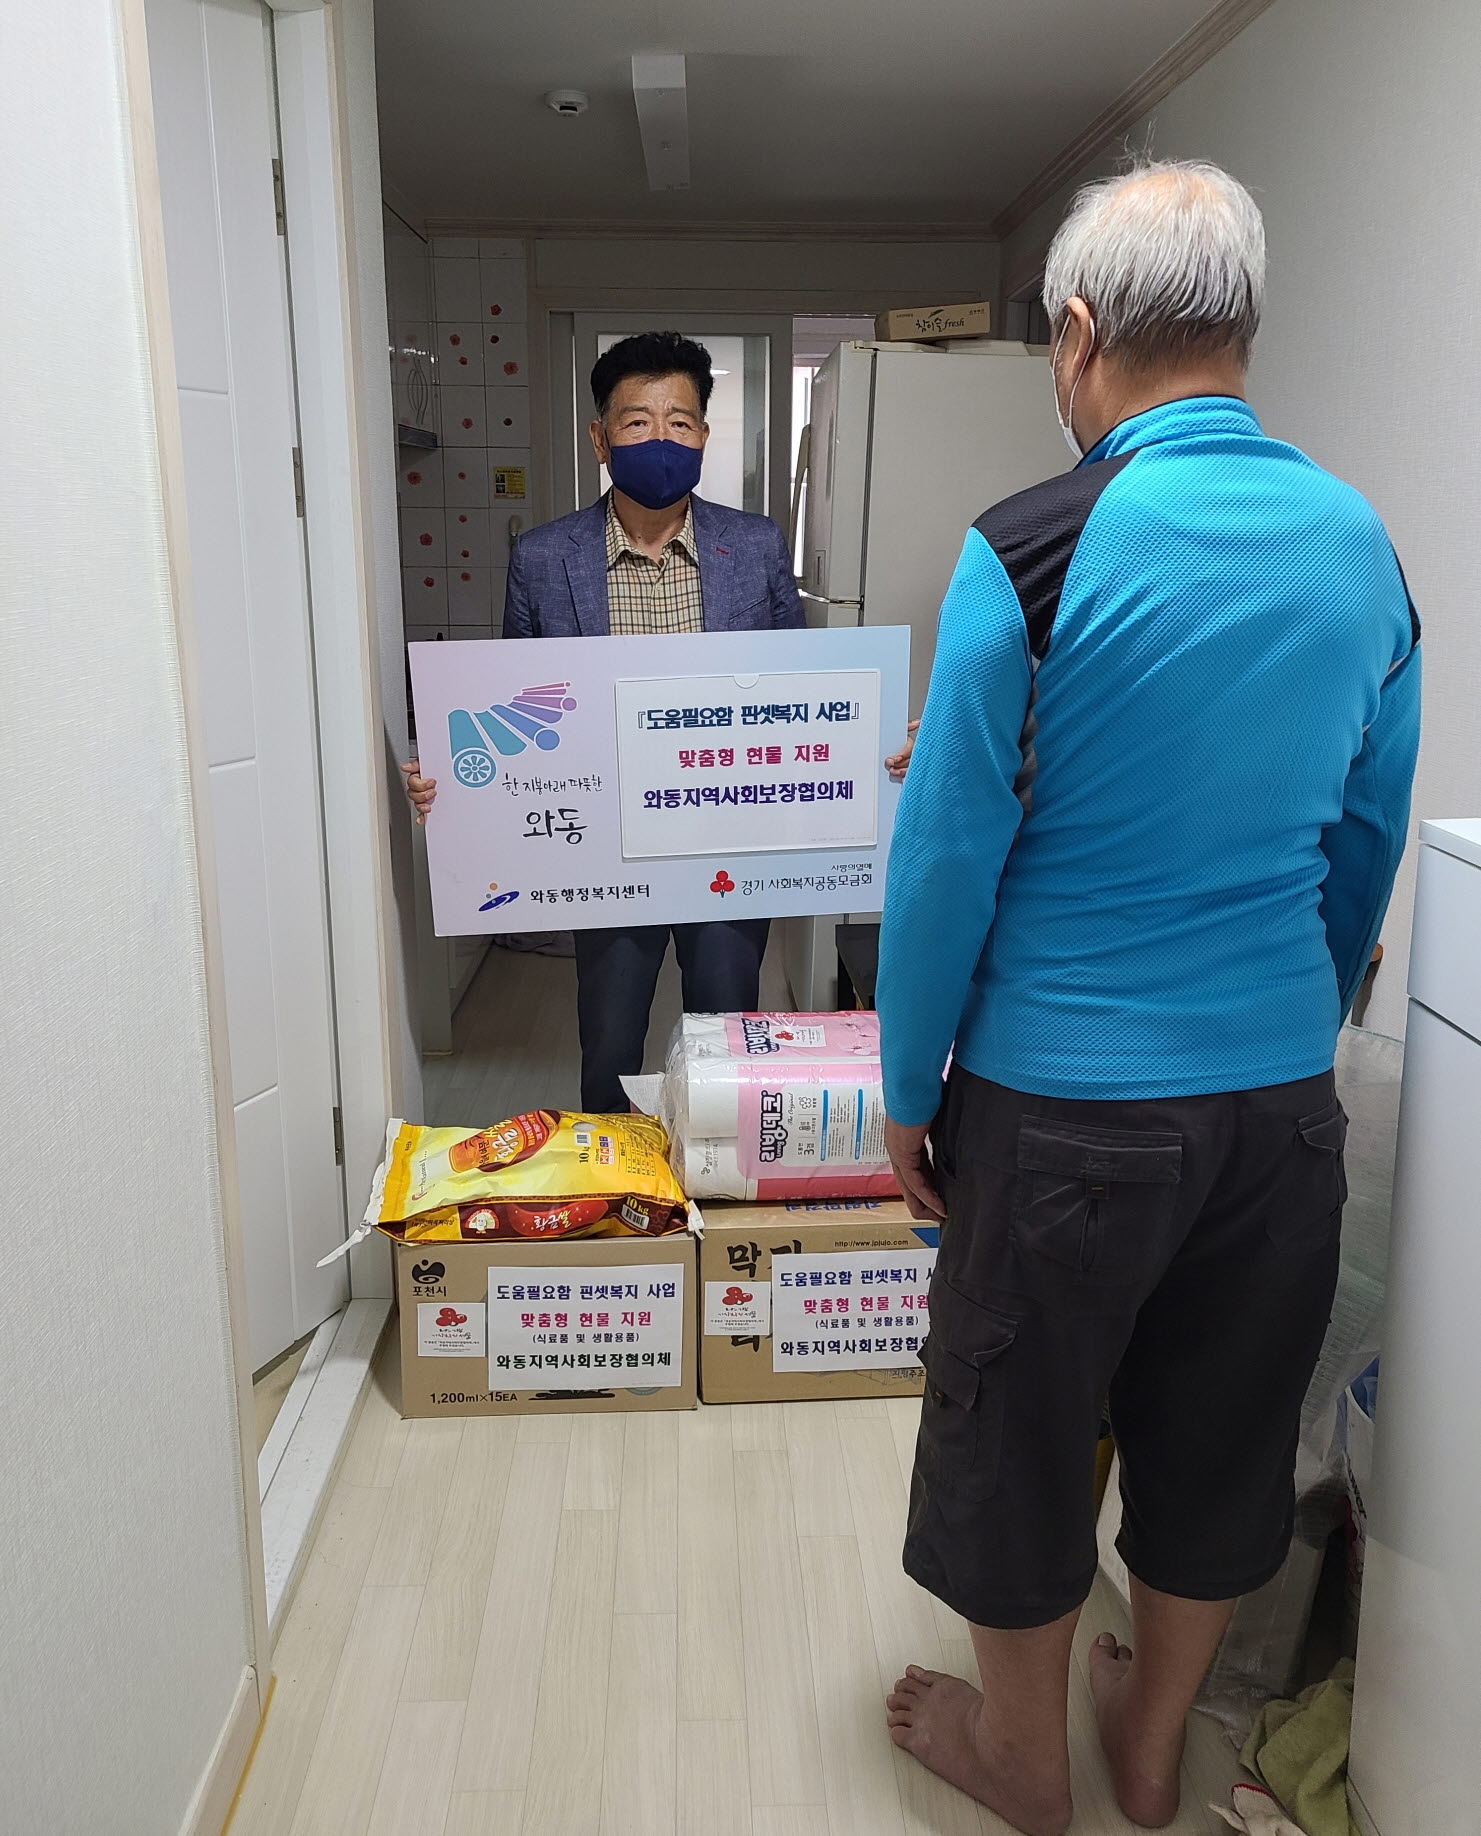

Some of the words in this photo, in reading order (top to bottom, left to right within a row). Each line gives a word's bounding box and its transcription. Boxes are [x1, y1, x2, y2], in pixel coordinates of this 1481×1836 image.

[941, 317, 965, 331] fresh
[678, 748, 735, 768] 맞춤형
[746, 745, 782, 765] 현물
[794, 744, 830, 762] 지원
[502, 772, 519, 797] 한
[643, 780, 854, 809] 와동지역사회보장협의체
[522, 808, 588, 845] 와동
[530, 884, 650, 904] 와동행정복지센터
[741, 879, 764, 896] 경기
[768, 873, 872, 891] 사회복지공동모금회
[760, 1090, 788, 1162] 리빙데코
[579, 1152, 590, 1164] 10
[626, 1196, 638, 1209] 10
[638, 1204, 649, 1216] kg
[780, 1271, 853, 1287] 도움필요함
[860, 1268, 917, 1284] 핀셋복지
[412, 1285, 447, 1298] 포천시
[496, 1285, 572, 1301] 도움필요함
[579, 1284, 638, 1300] 핀셋복지
[647, 1283, 676, 1298] 사업
[803, 1297, 849, 1314] 맞춤형
[860, 1296, 890, 1311] 현물
[520, 1312, 568, 1328] 맞춤형
[579, 1312, 609, 1327] 현물
[621, 1311, 652, 1326] 지원
[815, 1318, 850, 1329] (식료품
[857, 1318, 866, 1328] 및
[873, 1316, 919, 1327] 생활용품)
[532, 1333, 569, 1344] (식료품
[576, 1333, 586, 1344] 및
[592, 1333, 640, 1344] 생활용품)
[781, 1336, 928, 1355] 와동지역사회보장협
[496, 1352, 671, 1370] 와동지역사회보장협의체
